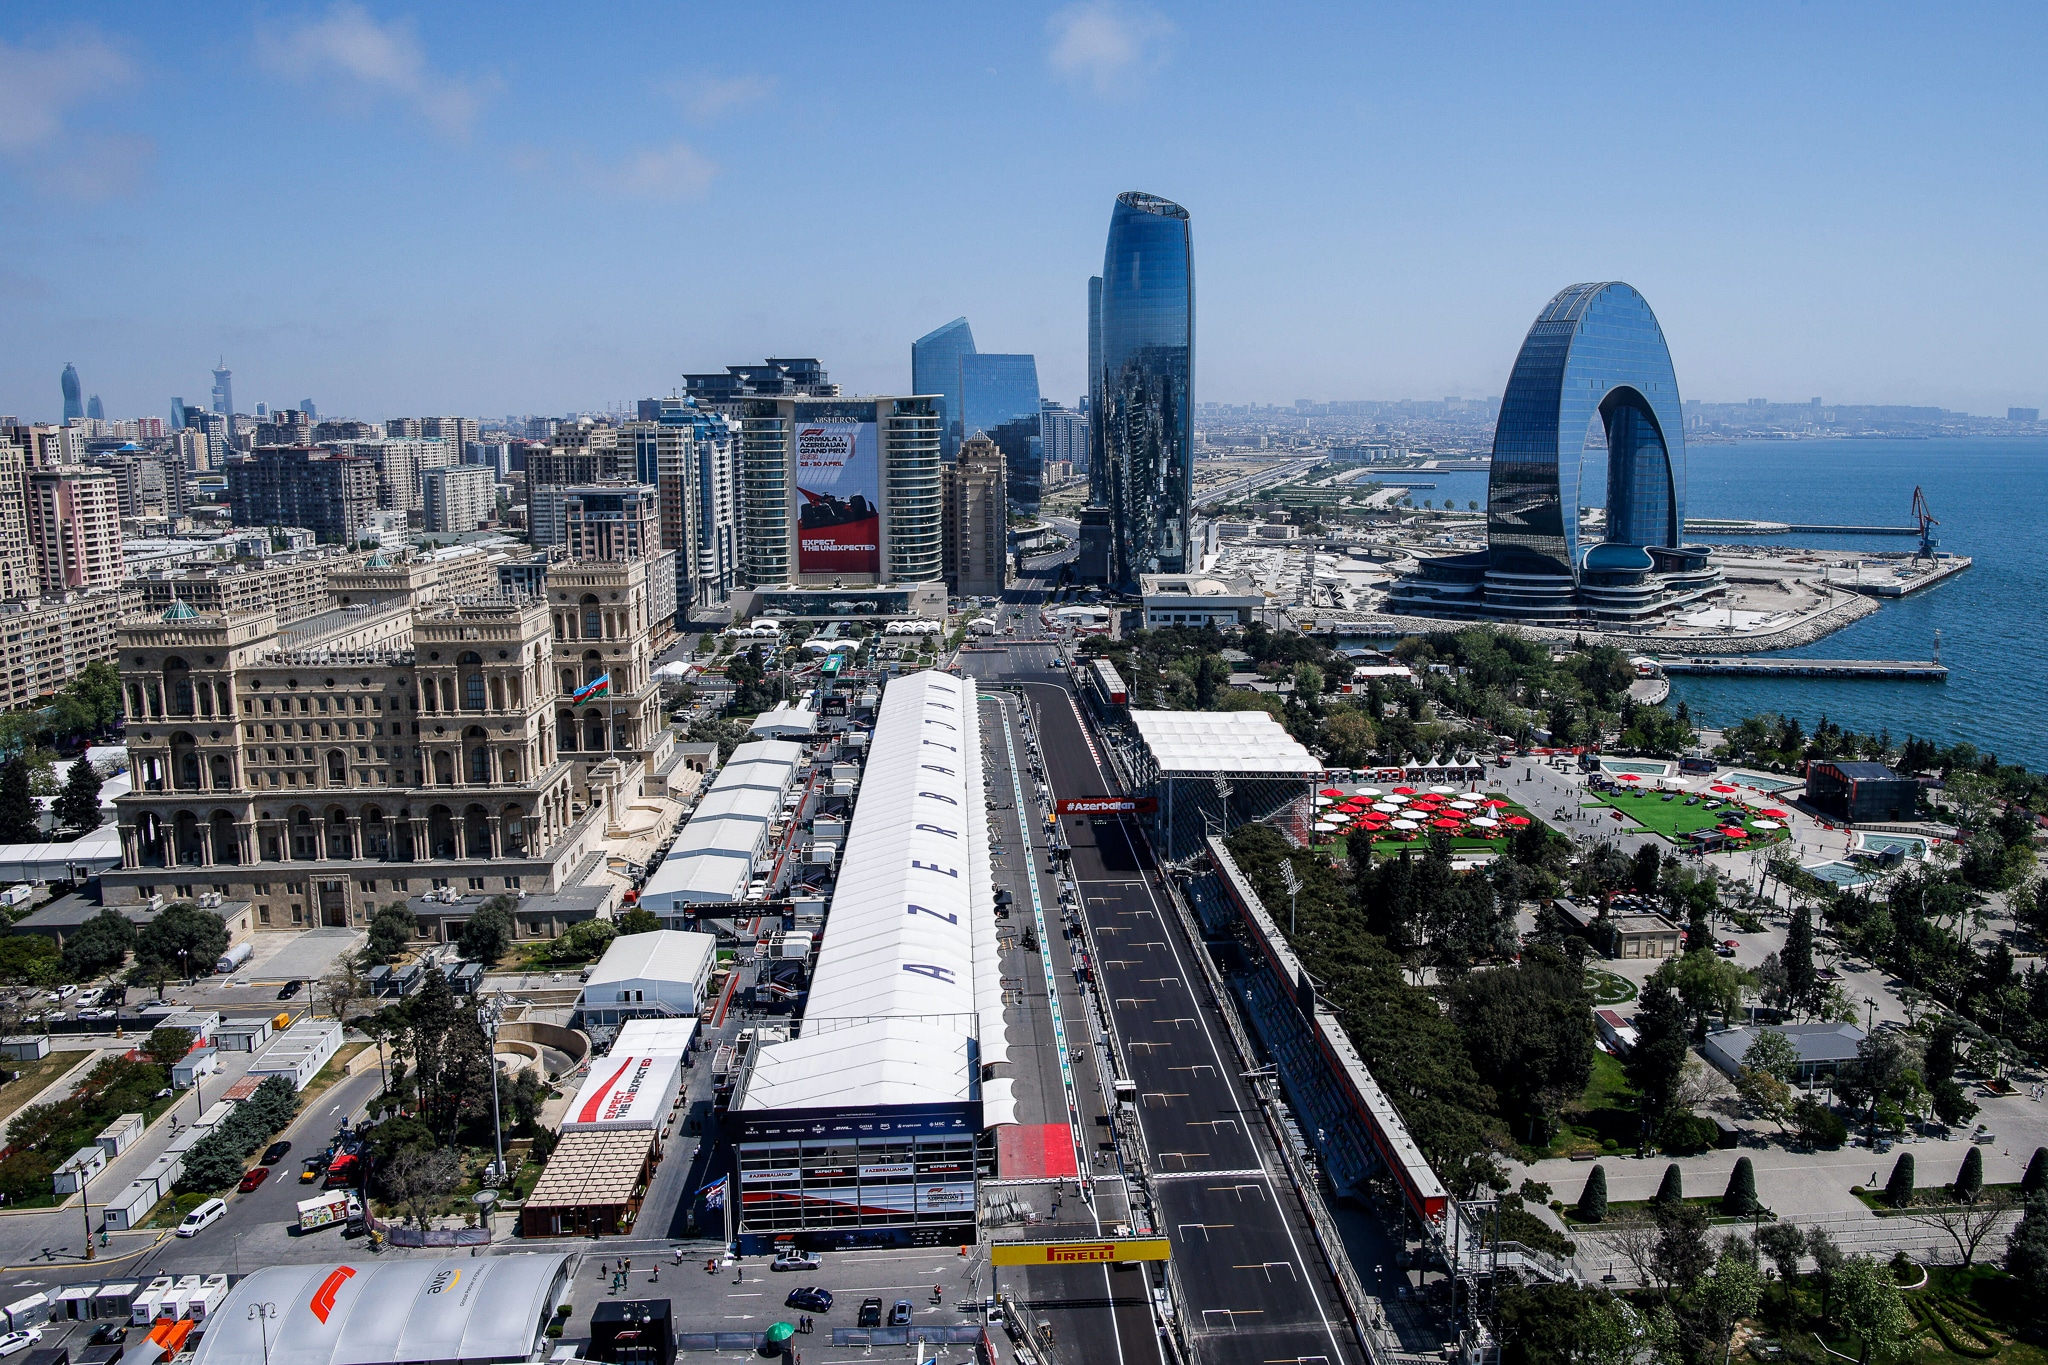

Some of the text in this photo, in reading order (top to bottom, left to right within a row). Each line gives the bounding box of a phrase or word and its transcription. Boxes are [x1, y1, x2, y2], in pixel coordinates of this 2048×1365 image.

[813, 416, 858, 424] ABSHERON
[820, 544, 876, 552] UNEXPECTED
[615, 1058, 652, 1119] THE UNEXPECTED
[603, 1090, 626, 1119] EXPECT
[1047, 1245, 1115, 1262] PIRELLI
[427, 1270, 452, 1294] aws
